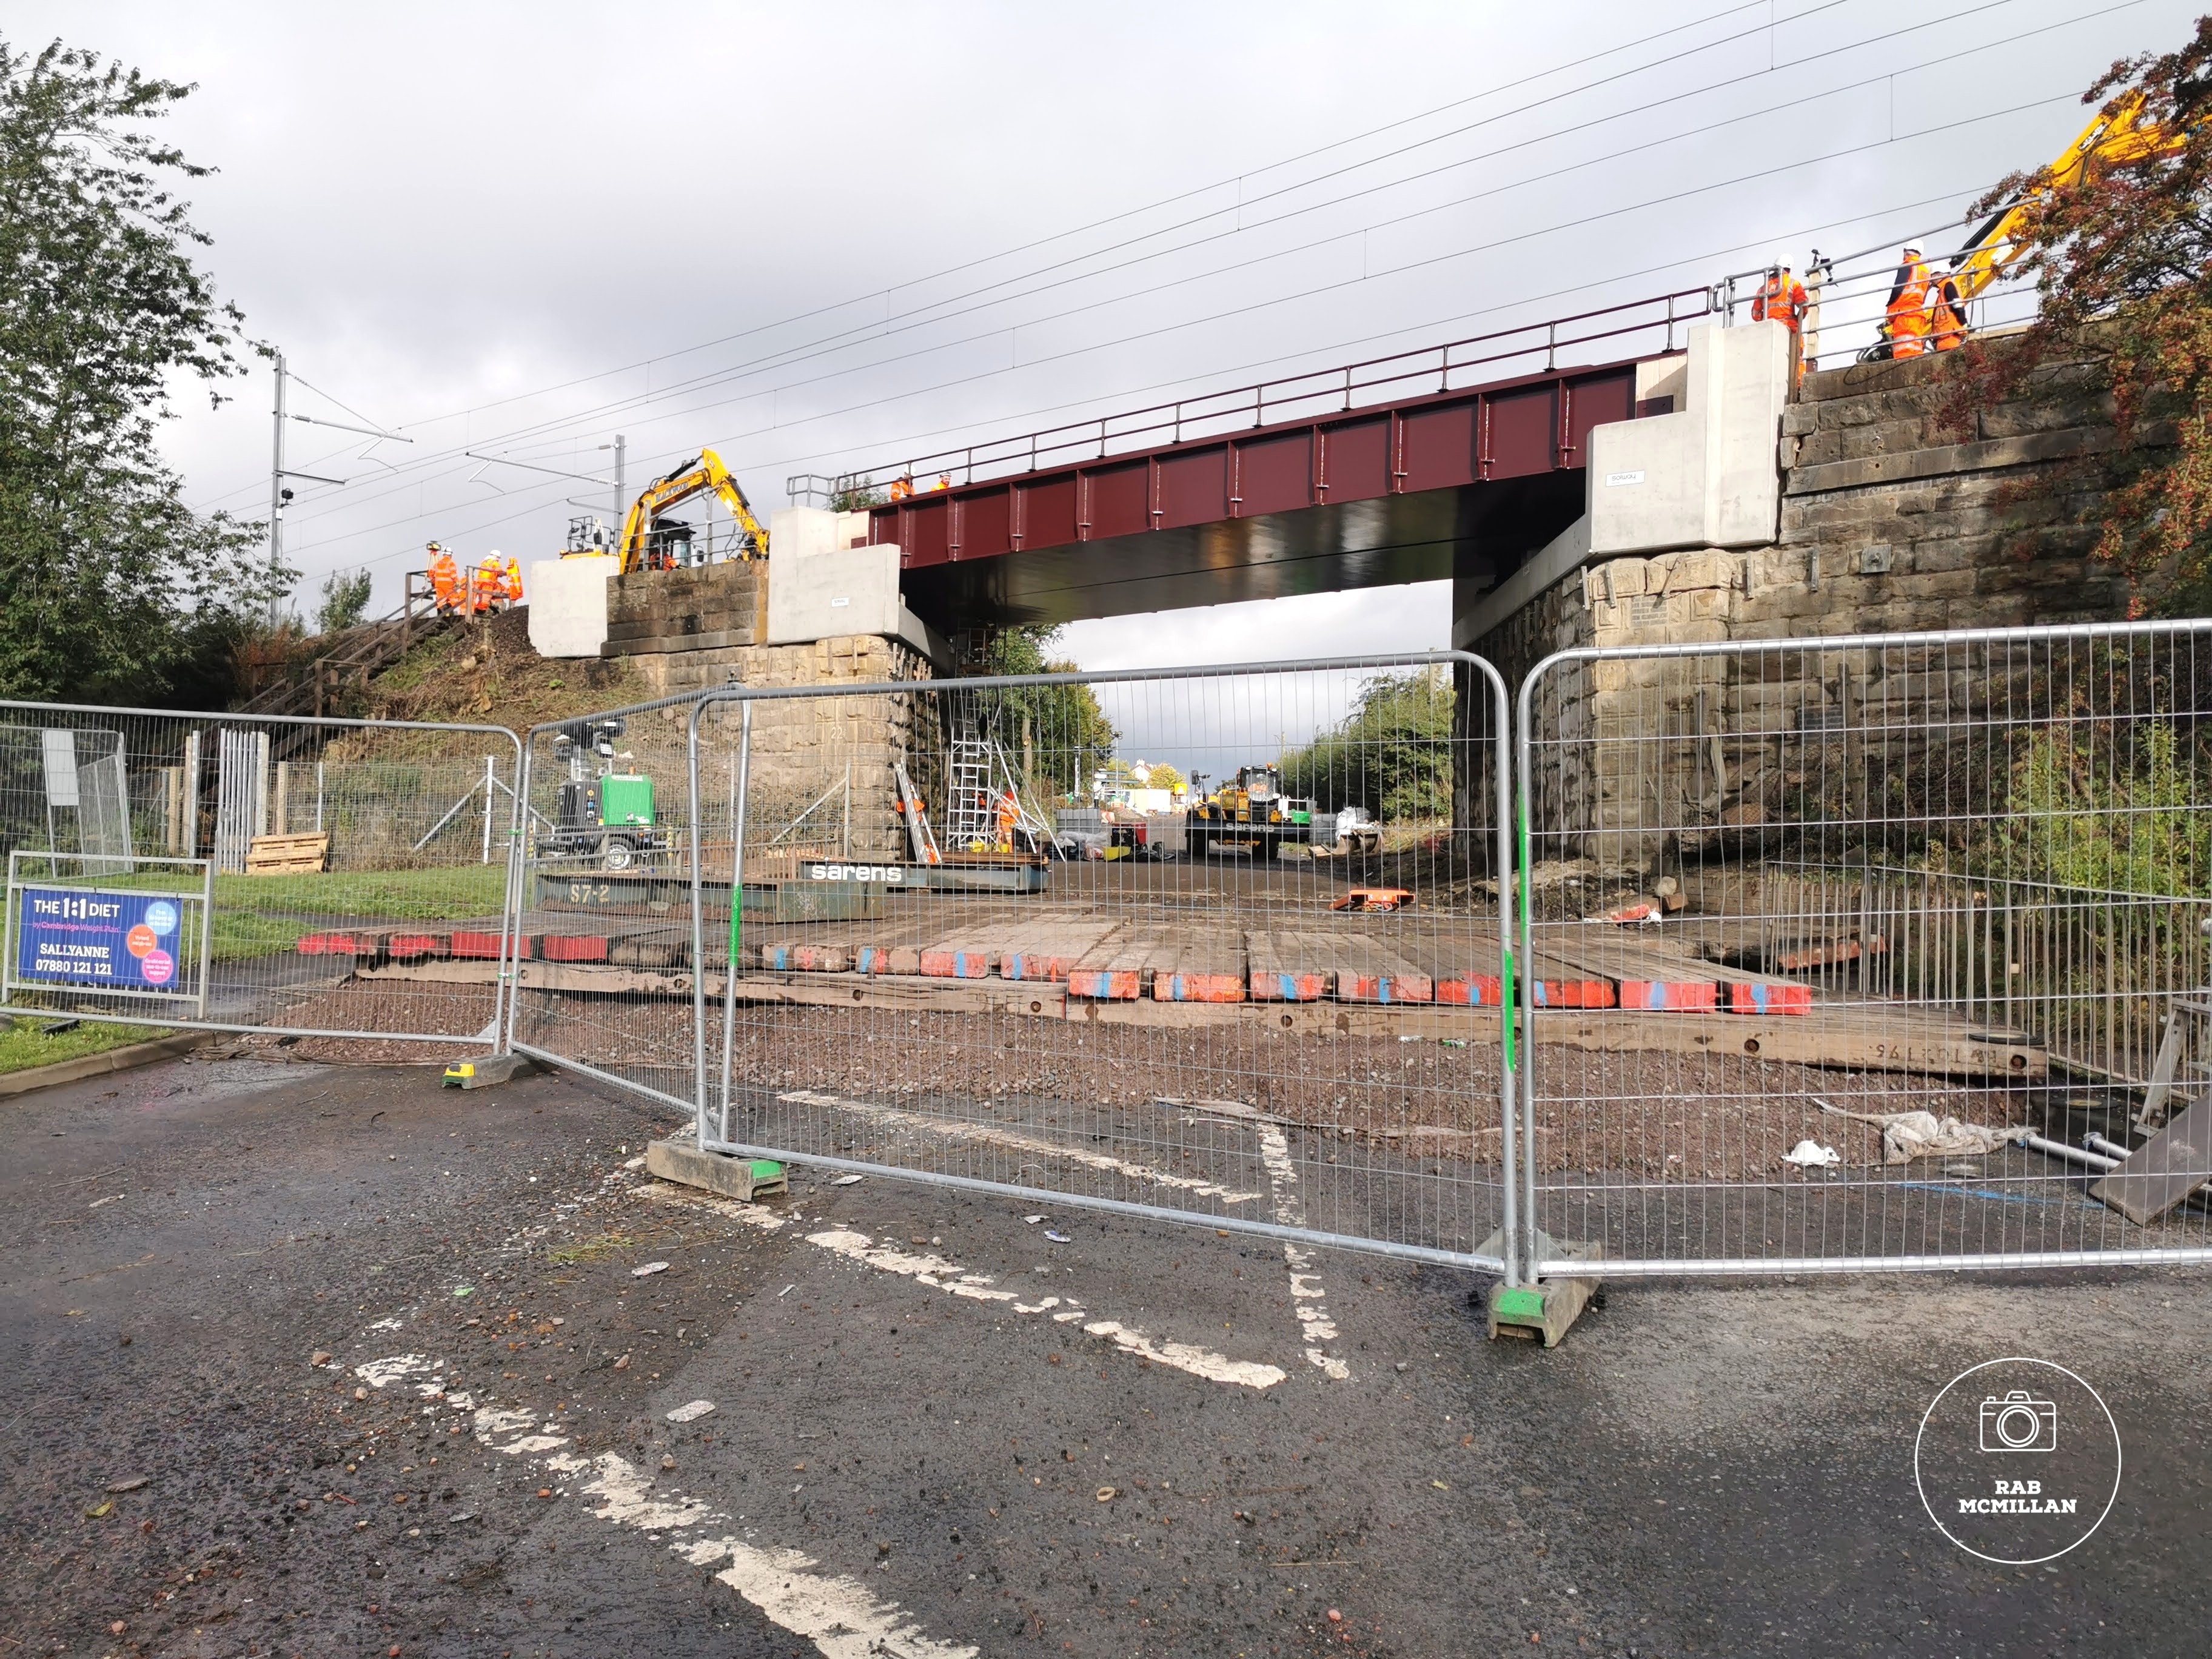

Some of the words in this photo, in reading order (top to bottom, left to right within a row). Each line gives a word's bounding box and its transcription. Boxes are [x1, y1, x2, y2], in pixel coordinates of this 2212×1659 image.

[1226, 823, 1275, 832] sarens
[811, 865, 902, 882] sarens
[34, 899, 60, 914] THE
[63, 897, 87, 919] 1:1
[89, 903, 120, 917] DIET
[41, 921, 79, 932] Cambridge
[80, 923, 104, 934] Weight
[104, 925, 119, 933] Plan
[40, 943, 110, 958] SALLYANNE
[36, 959, 70, 973] 07880
[73, 961, 92, 974] 121
[94, 963, 112, 975] 121
